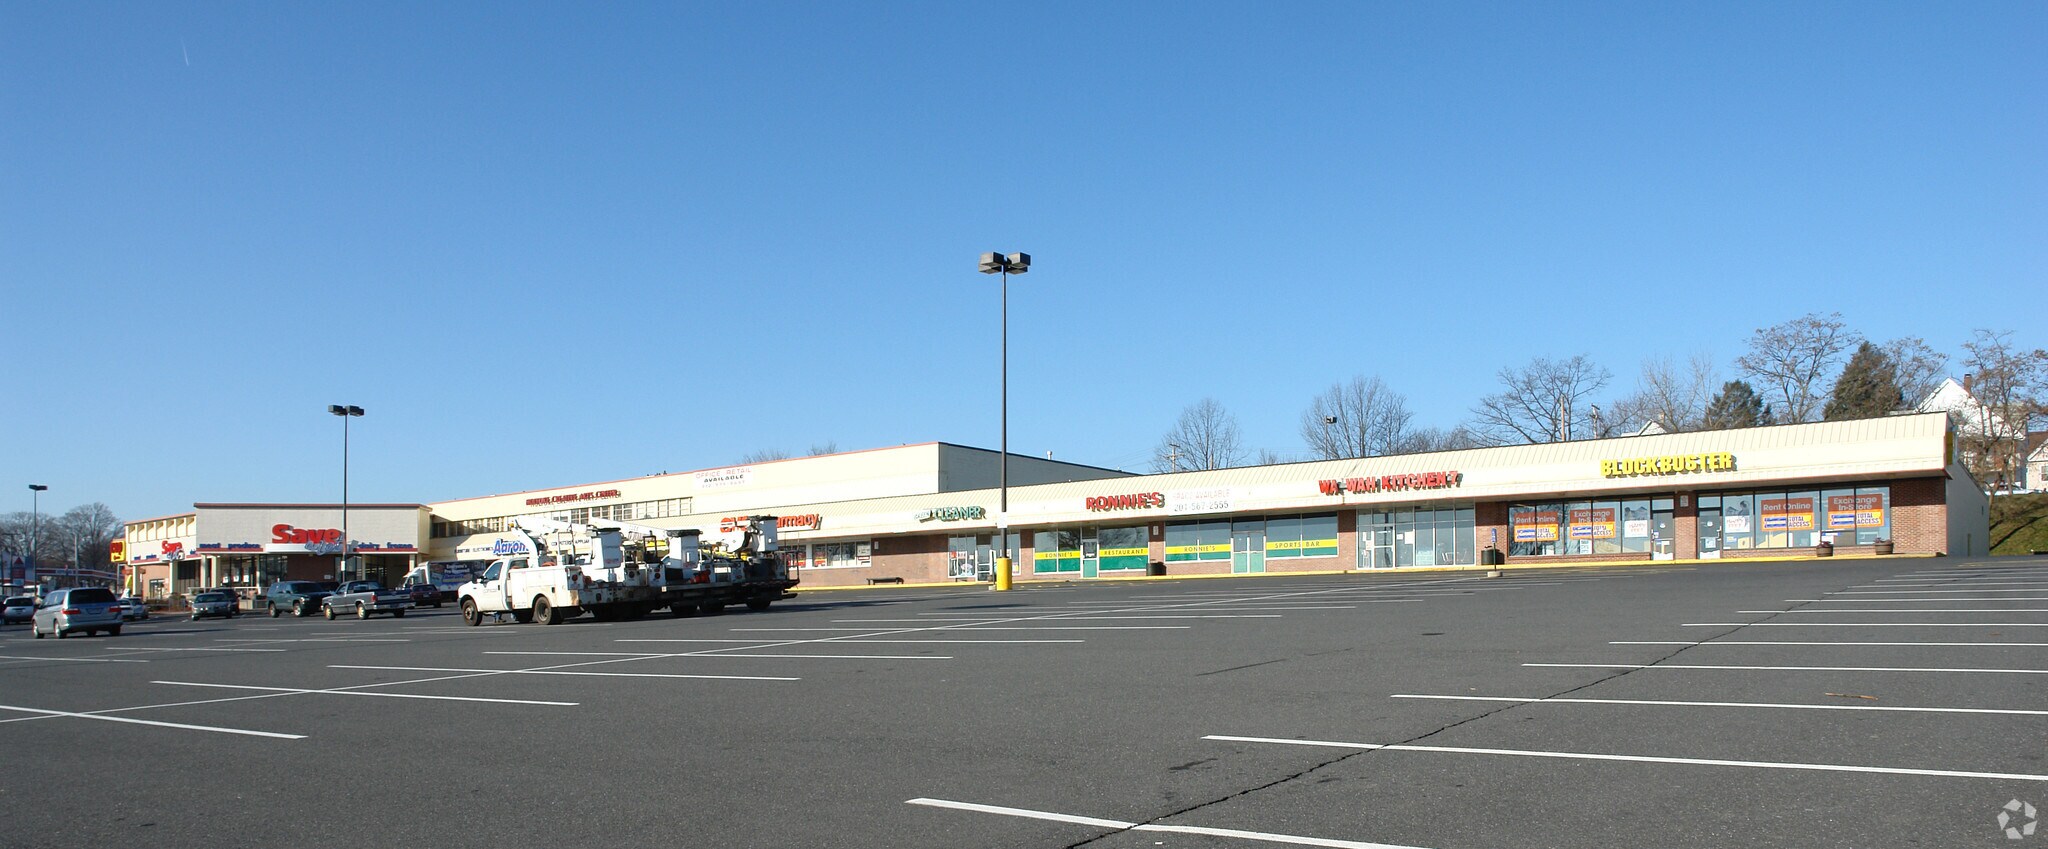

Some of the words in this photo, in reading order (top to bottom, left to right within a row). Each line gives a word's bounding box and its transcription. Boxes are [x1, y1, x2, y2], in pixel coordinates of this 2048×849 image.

[1601, 452, 1732, 476] BLOCKBUSTER
[695, 471, 721, 479] OFFICE
[703, 474, 744, 483] AVAILABLE
[1319, 480, 1339, 494] WA
[1346, 477, 1376, 492] WAH
[1381, 472, 1447, 490] KITCHEN
[1086, 491, 1161, 510] RONNIE'S
[1783, 502, 1811, 511] Online
[1833, 497, 1877, 506] Exchange
[272, 524, 340, 544] Save
